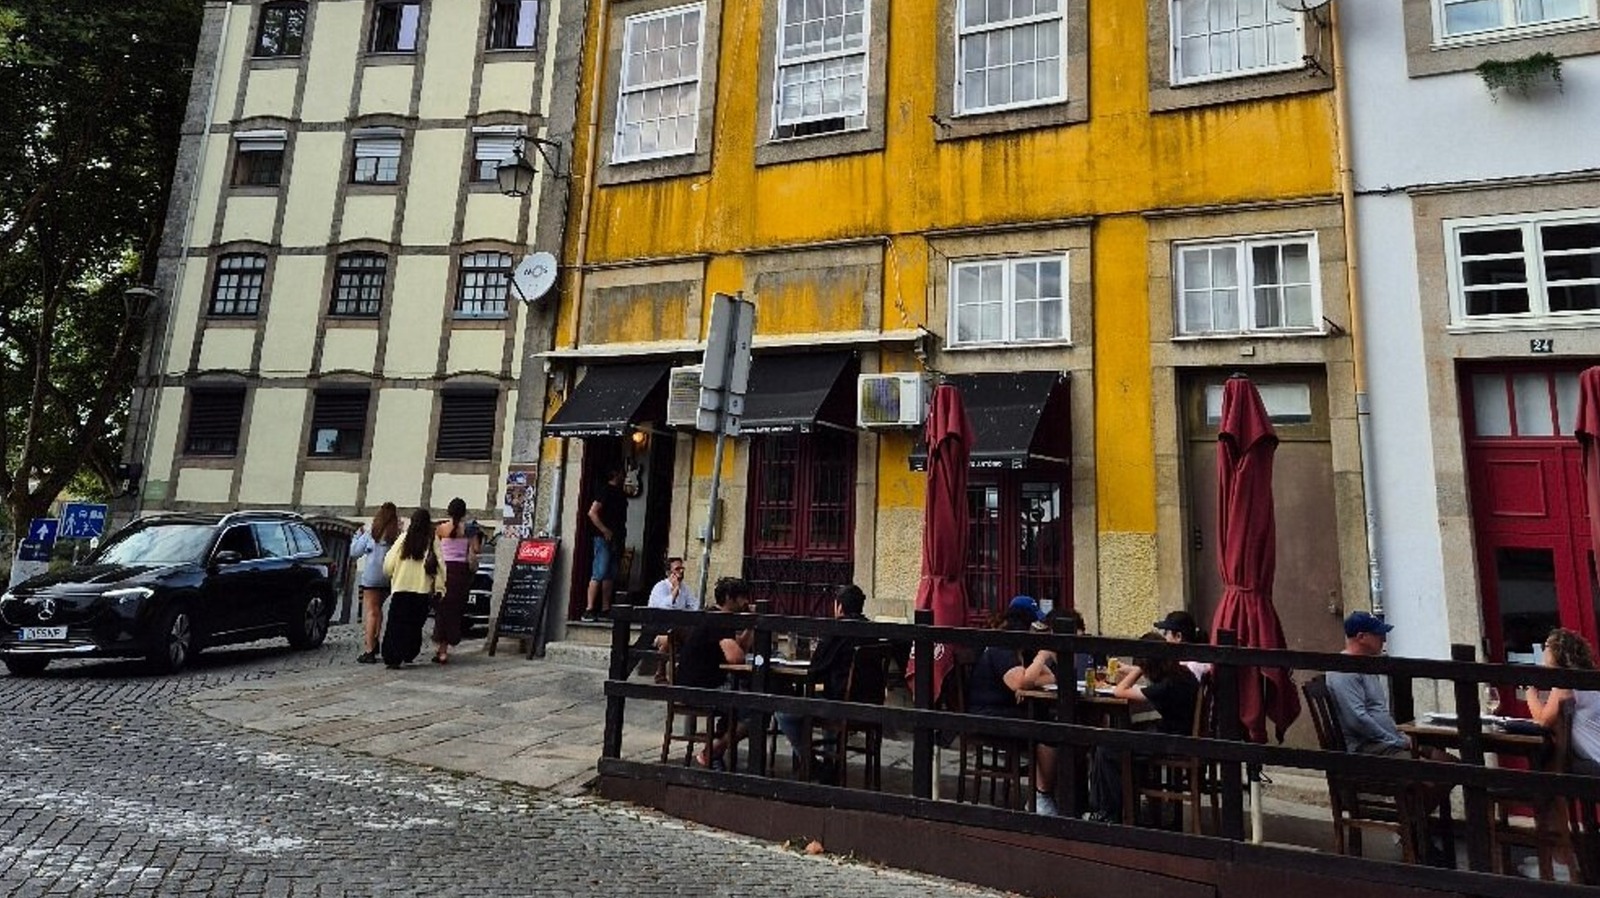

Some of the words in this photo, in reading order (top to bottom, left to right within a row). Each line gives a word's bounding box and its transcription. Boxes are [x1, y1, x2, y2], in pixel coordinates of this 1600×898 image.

[523, 264, 548, 278] NOS
[1533, 339, 1549, 351] 24
[520, 543, 551, 558] Coca-Cola
